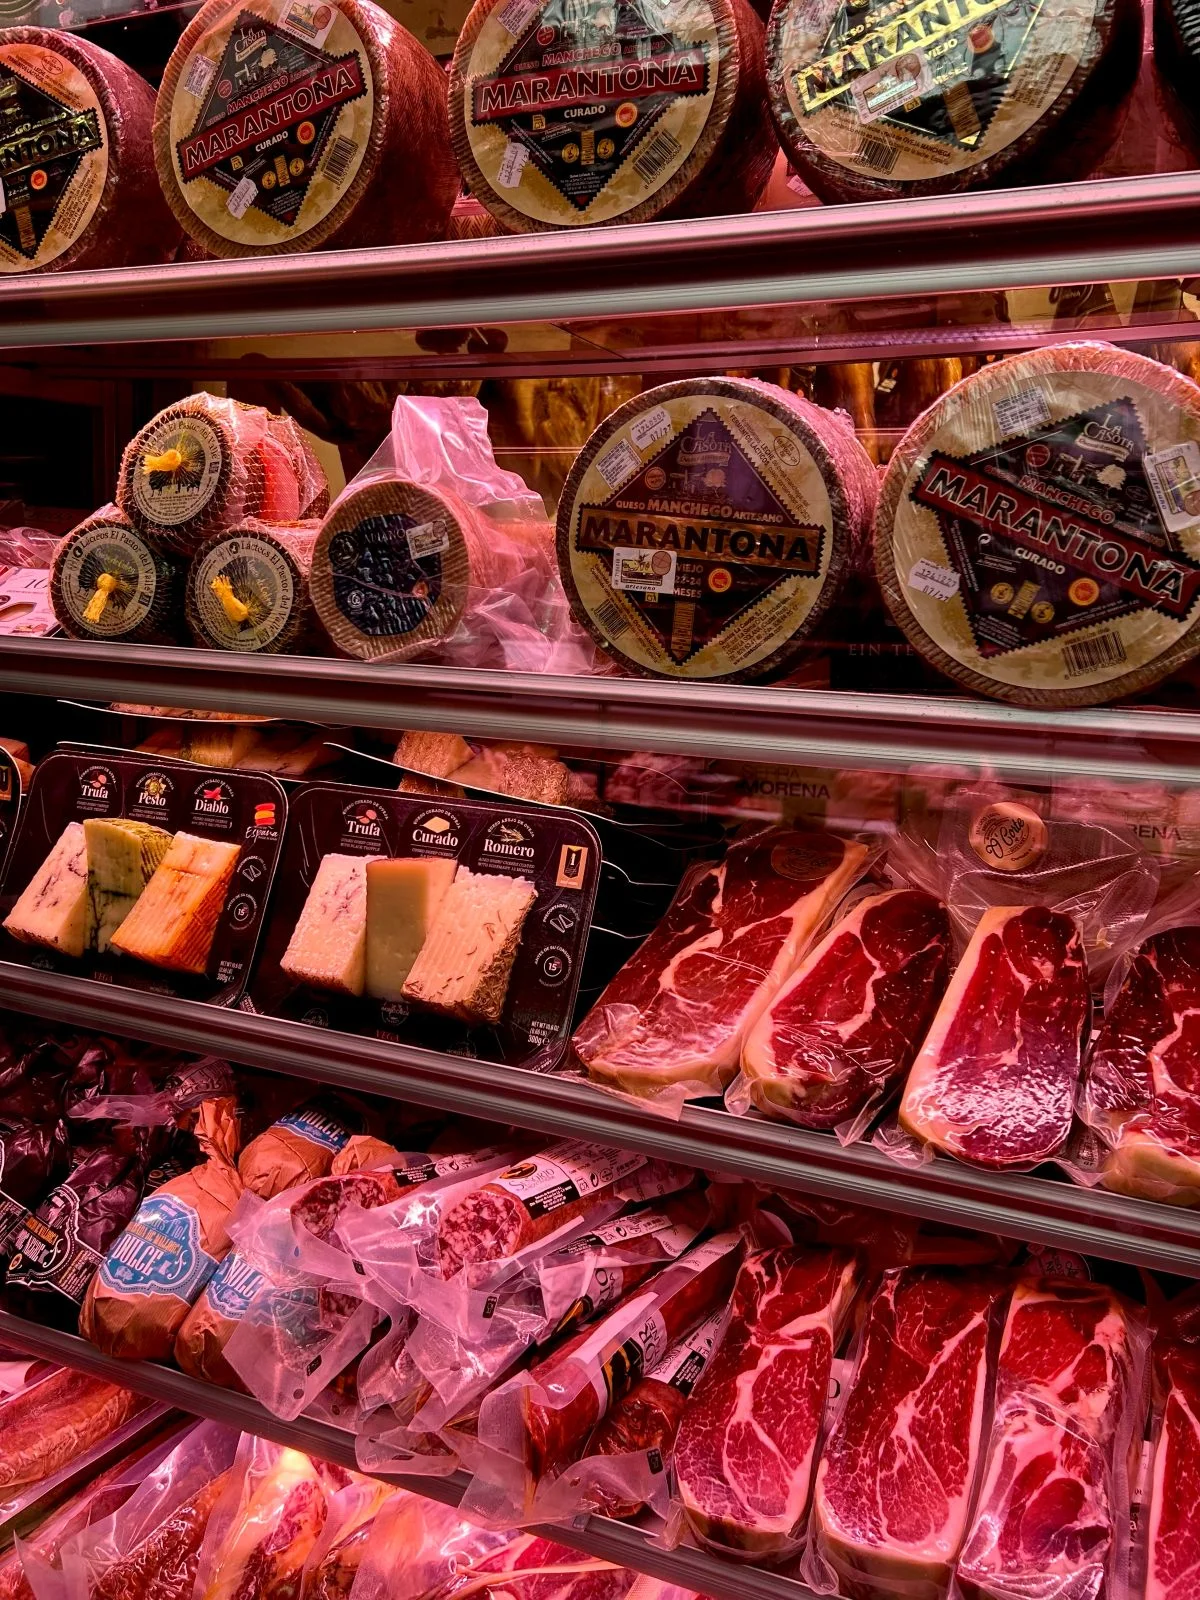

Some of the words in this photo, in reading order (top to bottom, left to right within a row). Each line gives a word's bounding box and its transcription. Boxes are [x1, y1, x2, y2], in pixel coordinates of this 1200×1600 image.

[234, 29, 267, 53] CASOTA
[240, 27, 254, 41] LA
[542, 43, 622, 67] MANCHEGO
[924, 38, 958, 60] VIEJO
[479, 56, 697, 113] MARANTONA
[226, 75, 289, 115] MANCHEGO
[185, 67, 356, 170] MARANTONA
[563, 105, 606, 119] CURADO
[0, 121, 96, 169] NTONA
[255, 130, 289, 153] CURADO
[696, 424, 715, 441] LA
[729, 414, 752, 443] FERMENTOS
[1100, 413, 1122, 435] LA
[680, 436, 732, 453] CASOTA
[1084, 421, 1135, 453] CASOTA
[208, 436, 220, 460] Valle
[760, 443, 775, 460] LECHE
[1019, 474, 1116, 525] MANCHEGO
[1150, 472, 1167, 510] artesano
[615, 501, 645, 511] QUESO
[647, 499, 733, 519] MANCHEGO
[733, 512, 783, 523] ARTESANO
[110, 531, 118, 540] El
[583, 515, 811, 562] MARANTONA
[925, 467, 1184, 603] MARANTONA
[139, 553, 151, 566] del
[676, 563, 704, 573] VIEJO
[1014, 547, 1066, 575] CURADO
[144, 566, 154, 591] Valle
[240, 540, 271, 557] Lácteos
[270, 554, 280, 564] El
[281, 595, 290, 609] del
[675, 575, 701, 586] 22-24
[672, 588, 702, 599] MESES
[849, 644, 881, 656] EIN
[891, 644, 915, 657] TE
[82, 785, 109, 799] Trufa
[138, 792, 166, 806] Pesto
[194, 798, 229, 814] Diablo
[378, 805, 389, 820] OVEJA
[347, 820, 381, 837] Trufa
[449, 815, 461, 829] OVEJA
[487, 820, 500, 833] QUESO
[523, 823, 535, 838] OVEJA
[245, 826, 279, 844] España
[412, 829, 458, 847] Curado
[484, 838, 535, 858] Romero
[543, 904, 568, 923] PRECORTADAS
[534, 951, 545, 966] ANTES
[556, 946, 573, 964] CONSUMO
[548, 962, 557, 971] 15
[527, 1034, 542, 1046] 300g
[298, 1110, 346, 1142] DULCE
[111, 1233, 164, 1276] DULCE
[223, 1256, 265, 1298] DULC
